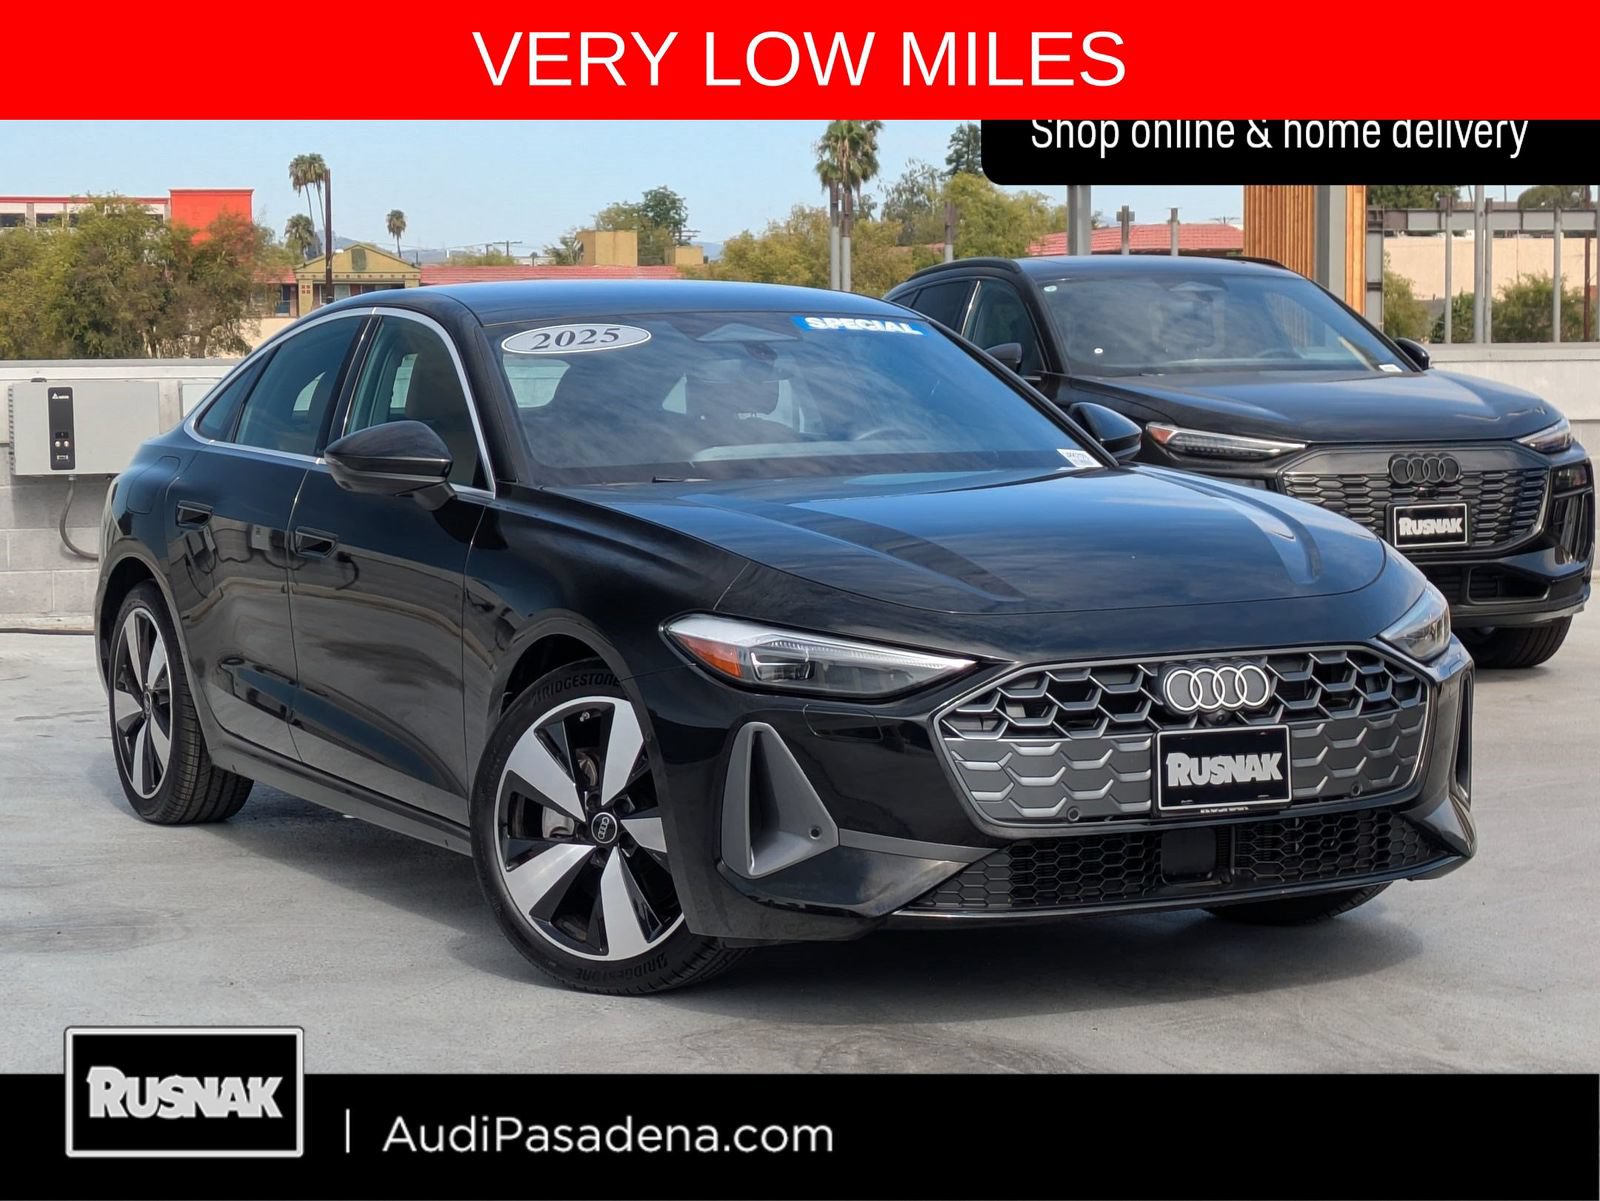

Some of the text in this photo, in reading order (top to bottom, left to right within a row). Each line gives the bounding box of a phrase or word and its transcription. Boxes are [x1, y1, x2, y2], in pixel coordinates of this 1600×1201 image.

[804, 316, 923, 336] SPECIAL
[531, 327, 621, 350] 2025
[1399, 517, 1463, 536] RUSNAK
[1166, 752, 1283, 787] RUSNAK
